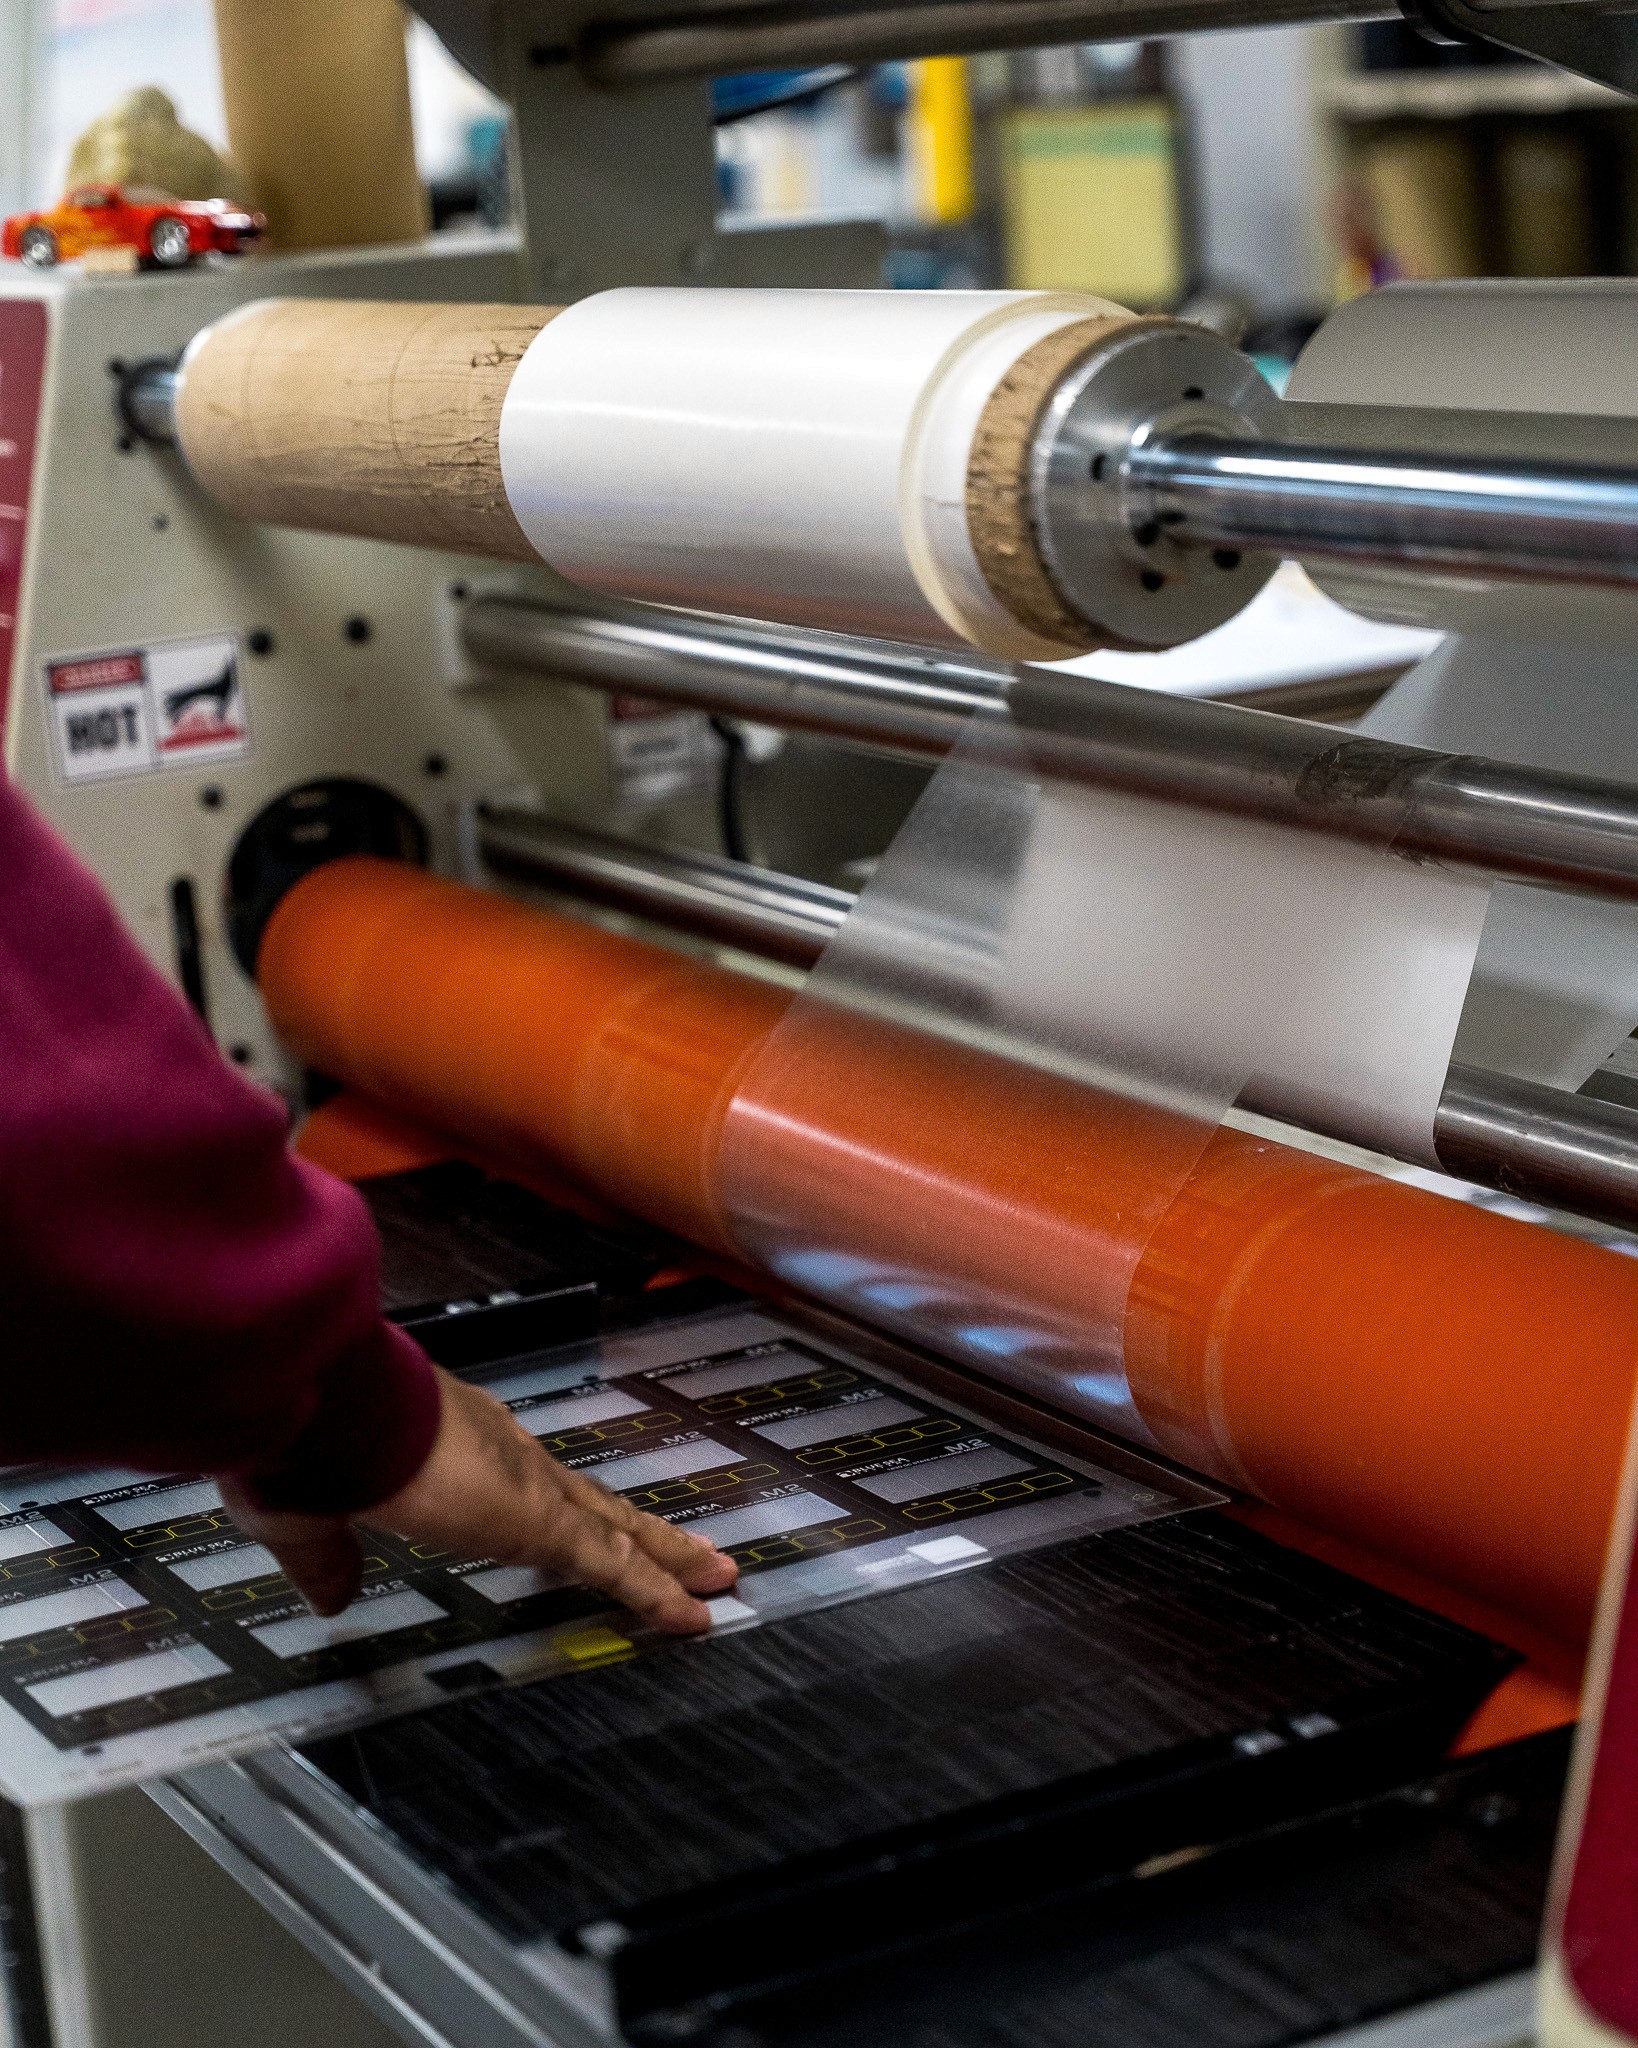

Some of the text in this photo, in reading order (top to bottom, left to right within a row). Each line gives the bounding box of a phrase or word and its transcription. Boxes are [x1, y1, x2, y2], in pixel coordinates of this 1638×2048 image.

[66, 703, 138, 754] HOT
[662, 1430, 703, 1444] M2
[944, 1438, 985, 1453] M2
[852, 1457, 910, 1475] BLUE SEA
[98, 1483, 160, 1501] BLUE SEA
[760, 1483, 804, 1498] M2
[695, 1503, 723, 1514] SEA
[0, 1511, 43, 1526] M2
[173, 1539, 236, 1558] BLUE SEA
[69, 1569, 116, 1586] M2
[360, 1579, 412, 1598] M2
